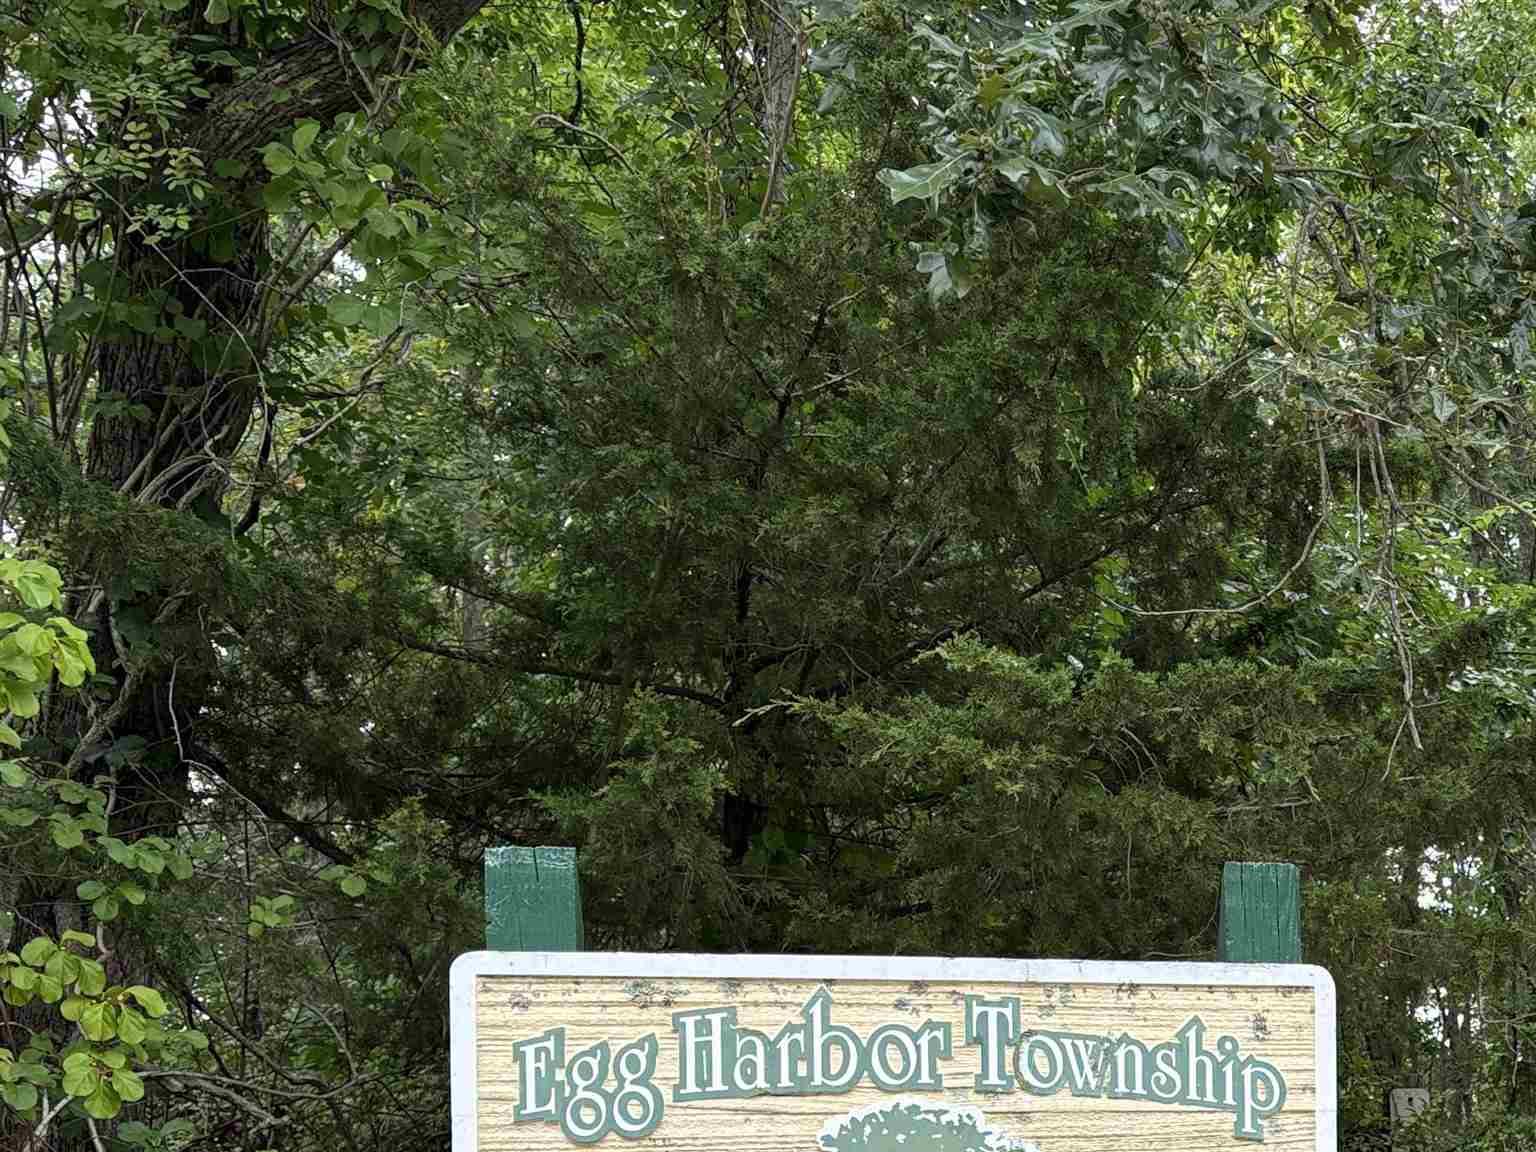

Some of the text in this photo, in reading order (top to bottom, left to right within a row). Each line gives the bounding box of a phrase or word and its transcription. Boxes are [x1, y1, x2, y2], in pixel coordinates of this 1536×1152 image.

[516, 996, 1283, 1138] Egg Harbor Township
